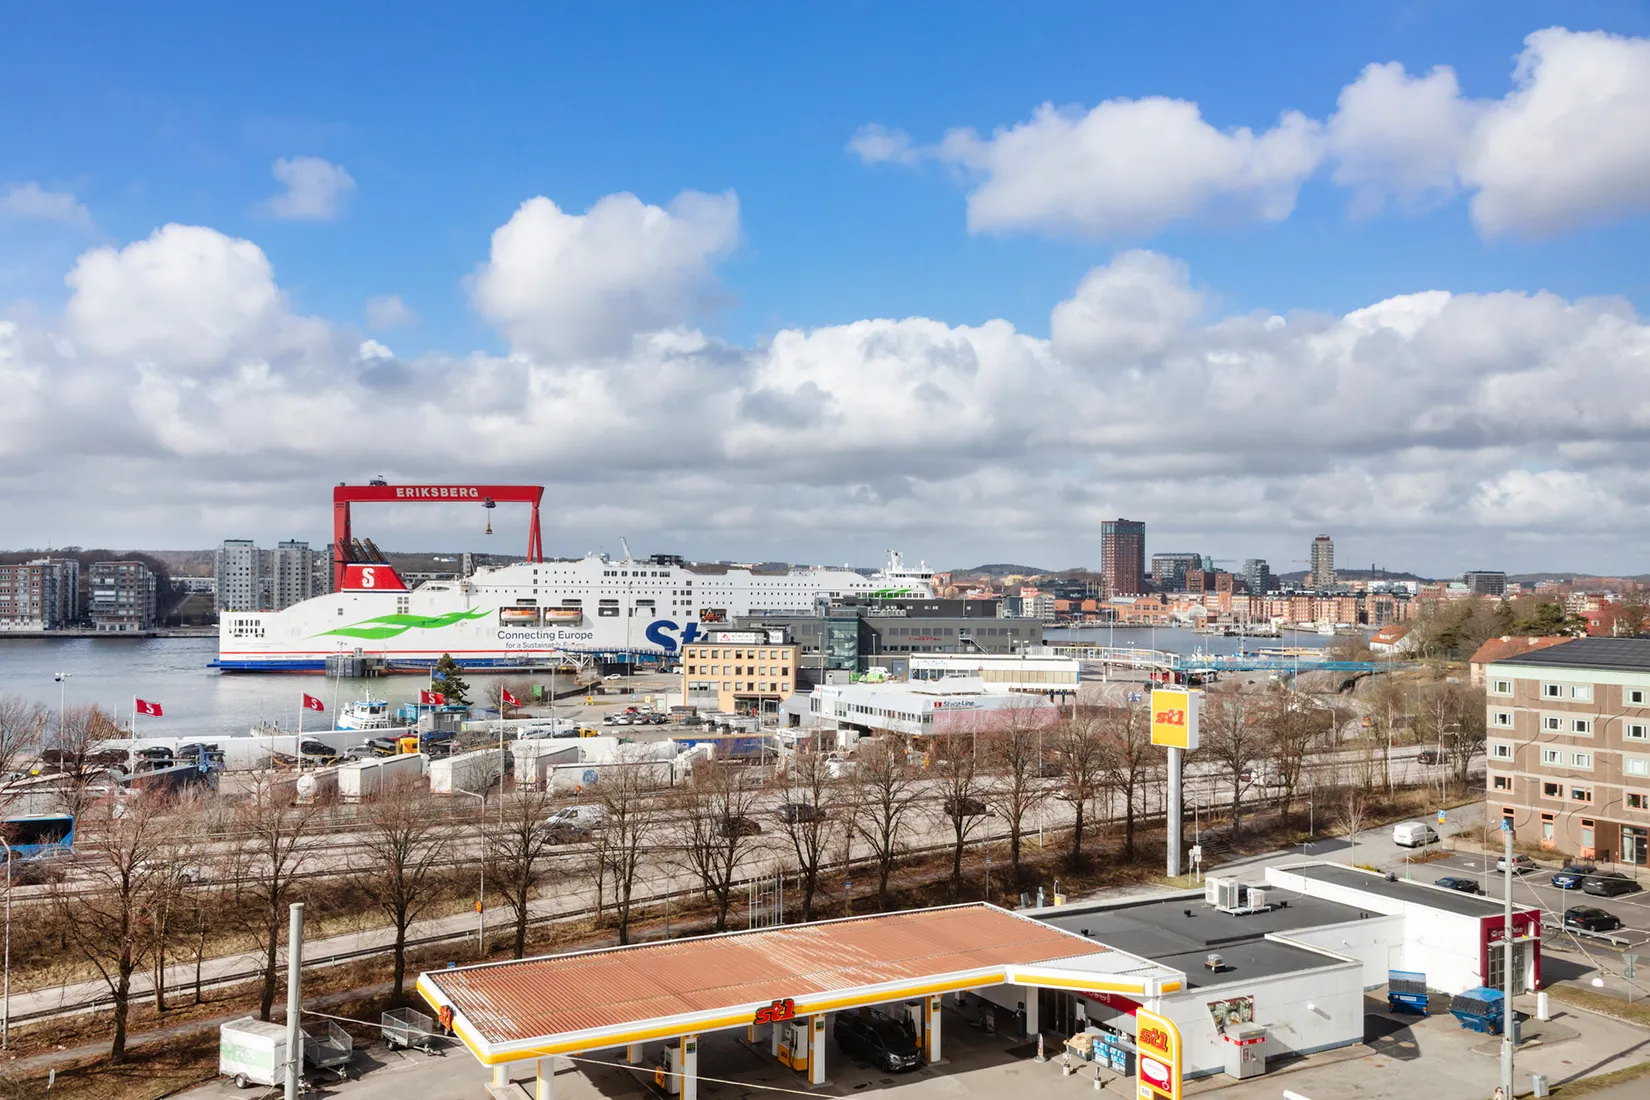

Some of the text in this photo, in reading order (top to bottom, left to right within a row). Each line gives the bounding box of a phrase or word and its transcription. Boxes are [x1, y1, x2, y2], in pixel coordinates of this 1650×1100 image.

[396, 487, 479, 498] ERIKSBERG
[362, 567, 375, 588] S
[497, 630, 593, 641] Connecting Europe
[646, 620, 704, 652] St
[312, 698, 318, 709] S
[428, 693, 436, 704] S
[146, 703, 154, 714] S
[1155, 709, 1185, 726] st1
[753, 998, 795, 1025] st1
[1139, 1028, 1168, 1052] st1
